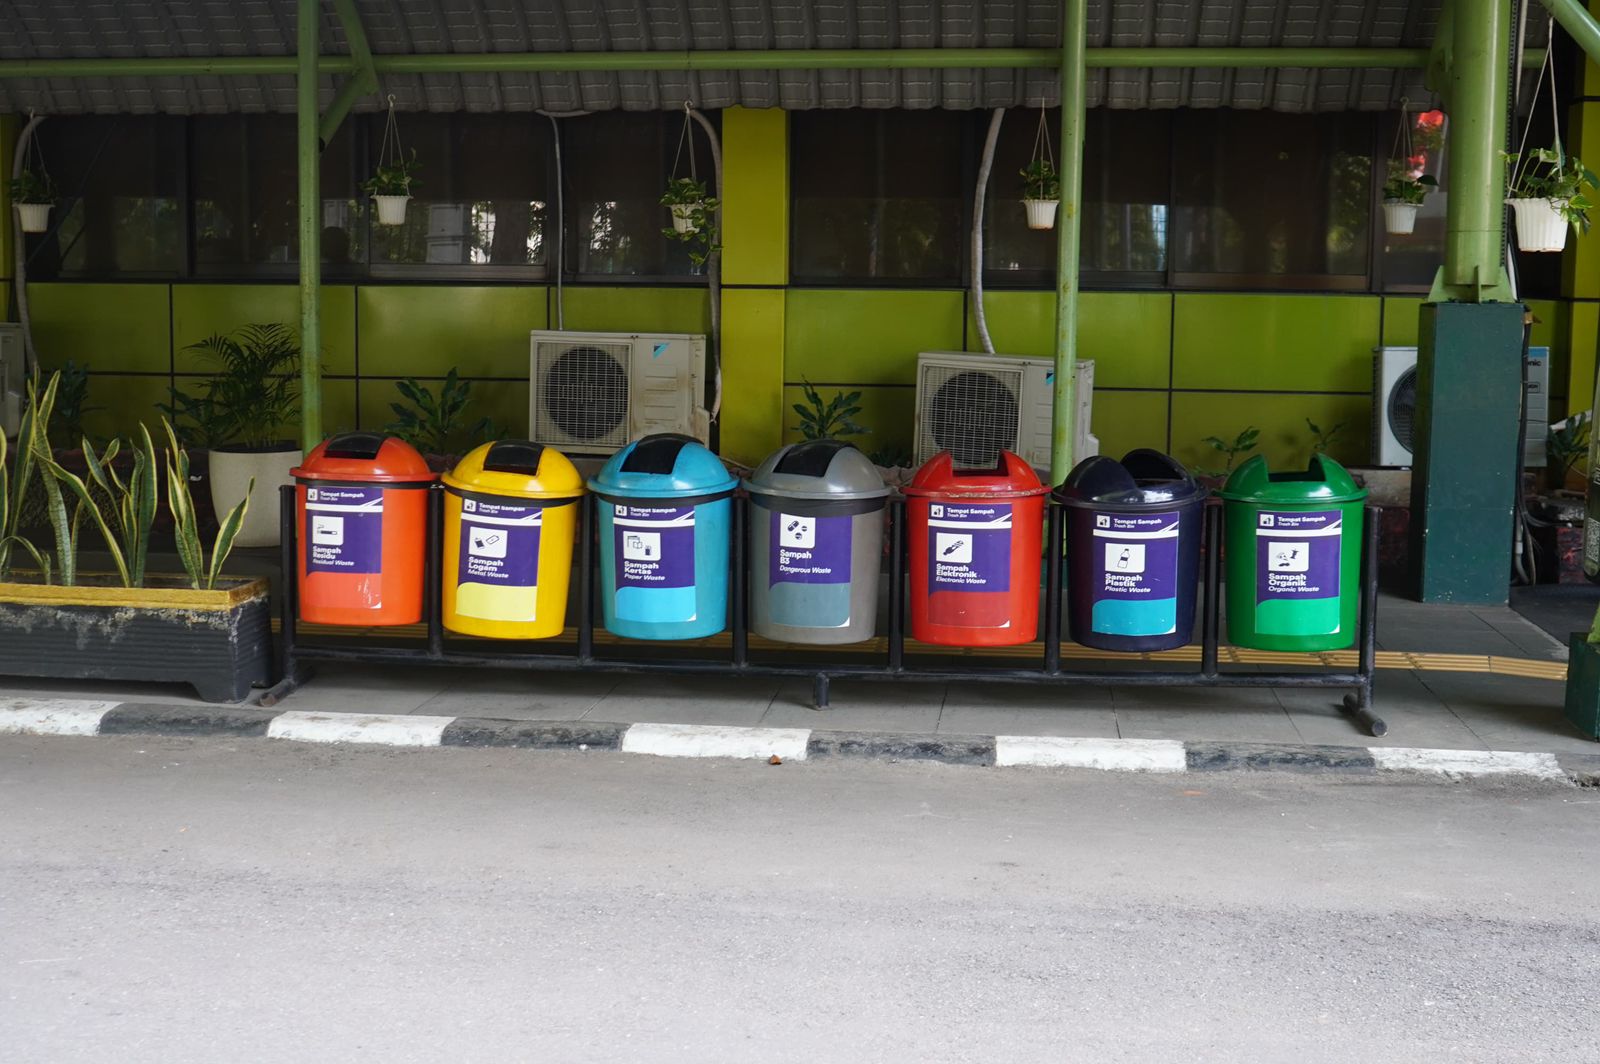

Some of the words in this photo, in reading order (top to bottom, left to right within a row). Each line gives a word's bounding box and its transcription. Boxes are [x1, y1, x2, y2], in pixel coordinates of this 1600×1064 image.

[313, 546, 341, 554] Sampah
[780, 549, 812, 559] Sampah
[469, 557, 503, 566] Sampah
[780, 556, 790, 564] B3
[469, 562, 497, 571] Logam
[624, 561, 659, 569] Sampah
[936, 563, 969, 572] Sampah
[780, 565, 811, 574] Dangerous
[936, 570, 977, 578] Elektronik
[1105, 573, 1143, 581] Sampah
